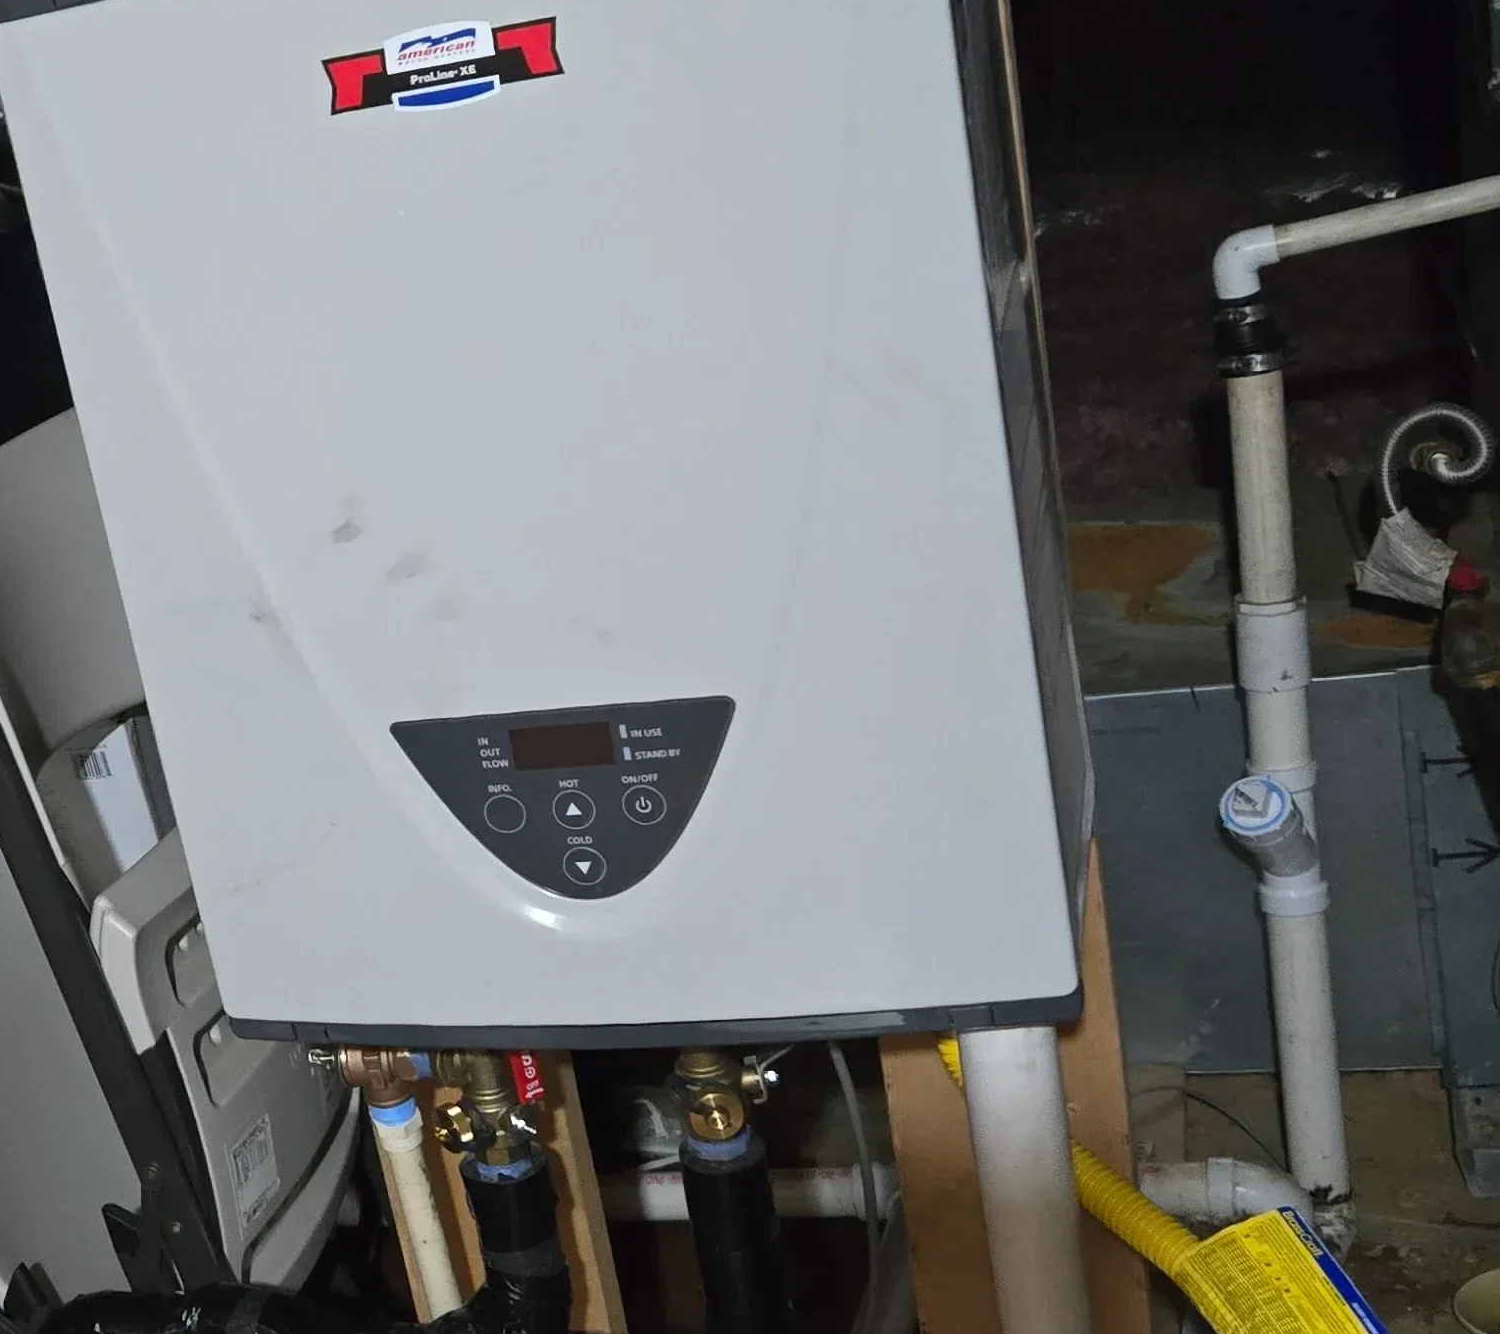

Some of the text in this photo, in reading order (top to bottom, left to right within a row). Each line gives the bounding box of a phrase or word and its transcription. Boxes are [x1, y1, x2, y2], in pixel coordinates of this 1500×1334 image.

[398, 41, 475, 61] american
[459, 64, 477, 77] XE
[630, 727, 663, 738] IN USE
[477, 737, 489, 746] IN
[480, 747, 501, 758] OUT
[482, 758, 509, 769] FLOW
[559, 779, 579, 788] HOT
[621, 773, 659, 784] ON/OFF
[487, 784, 513, 793] INFO.
[567, 835, 593, 845] COLD
[1282, 1210, 1324, 1258] BrassCraft
